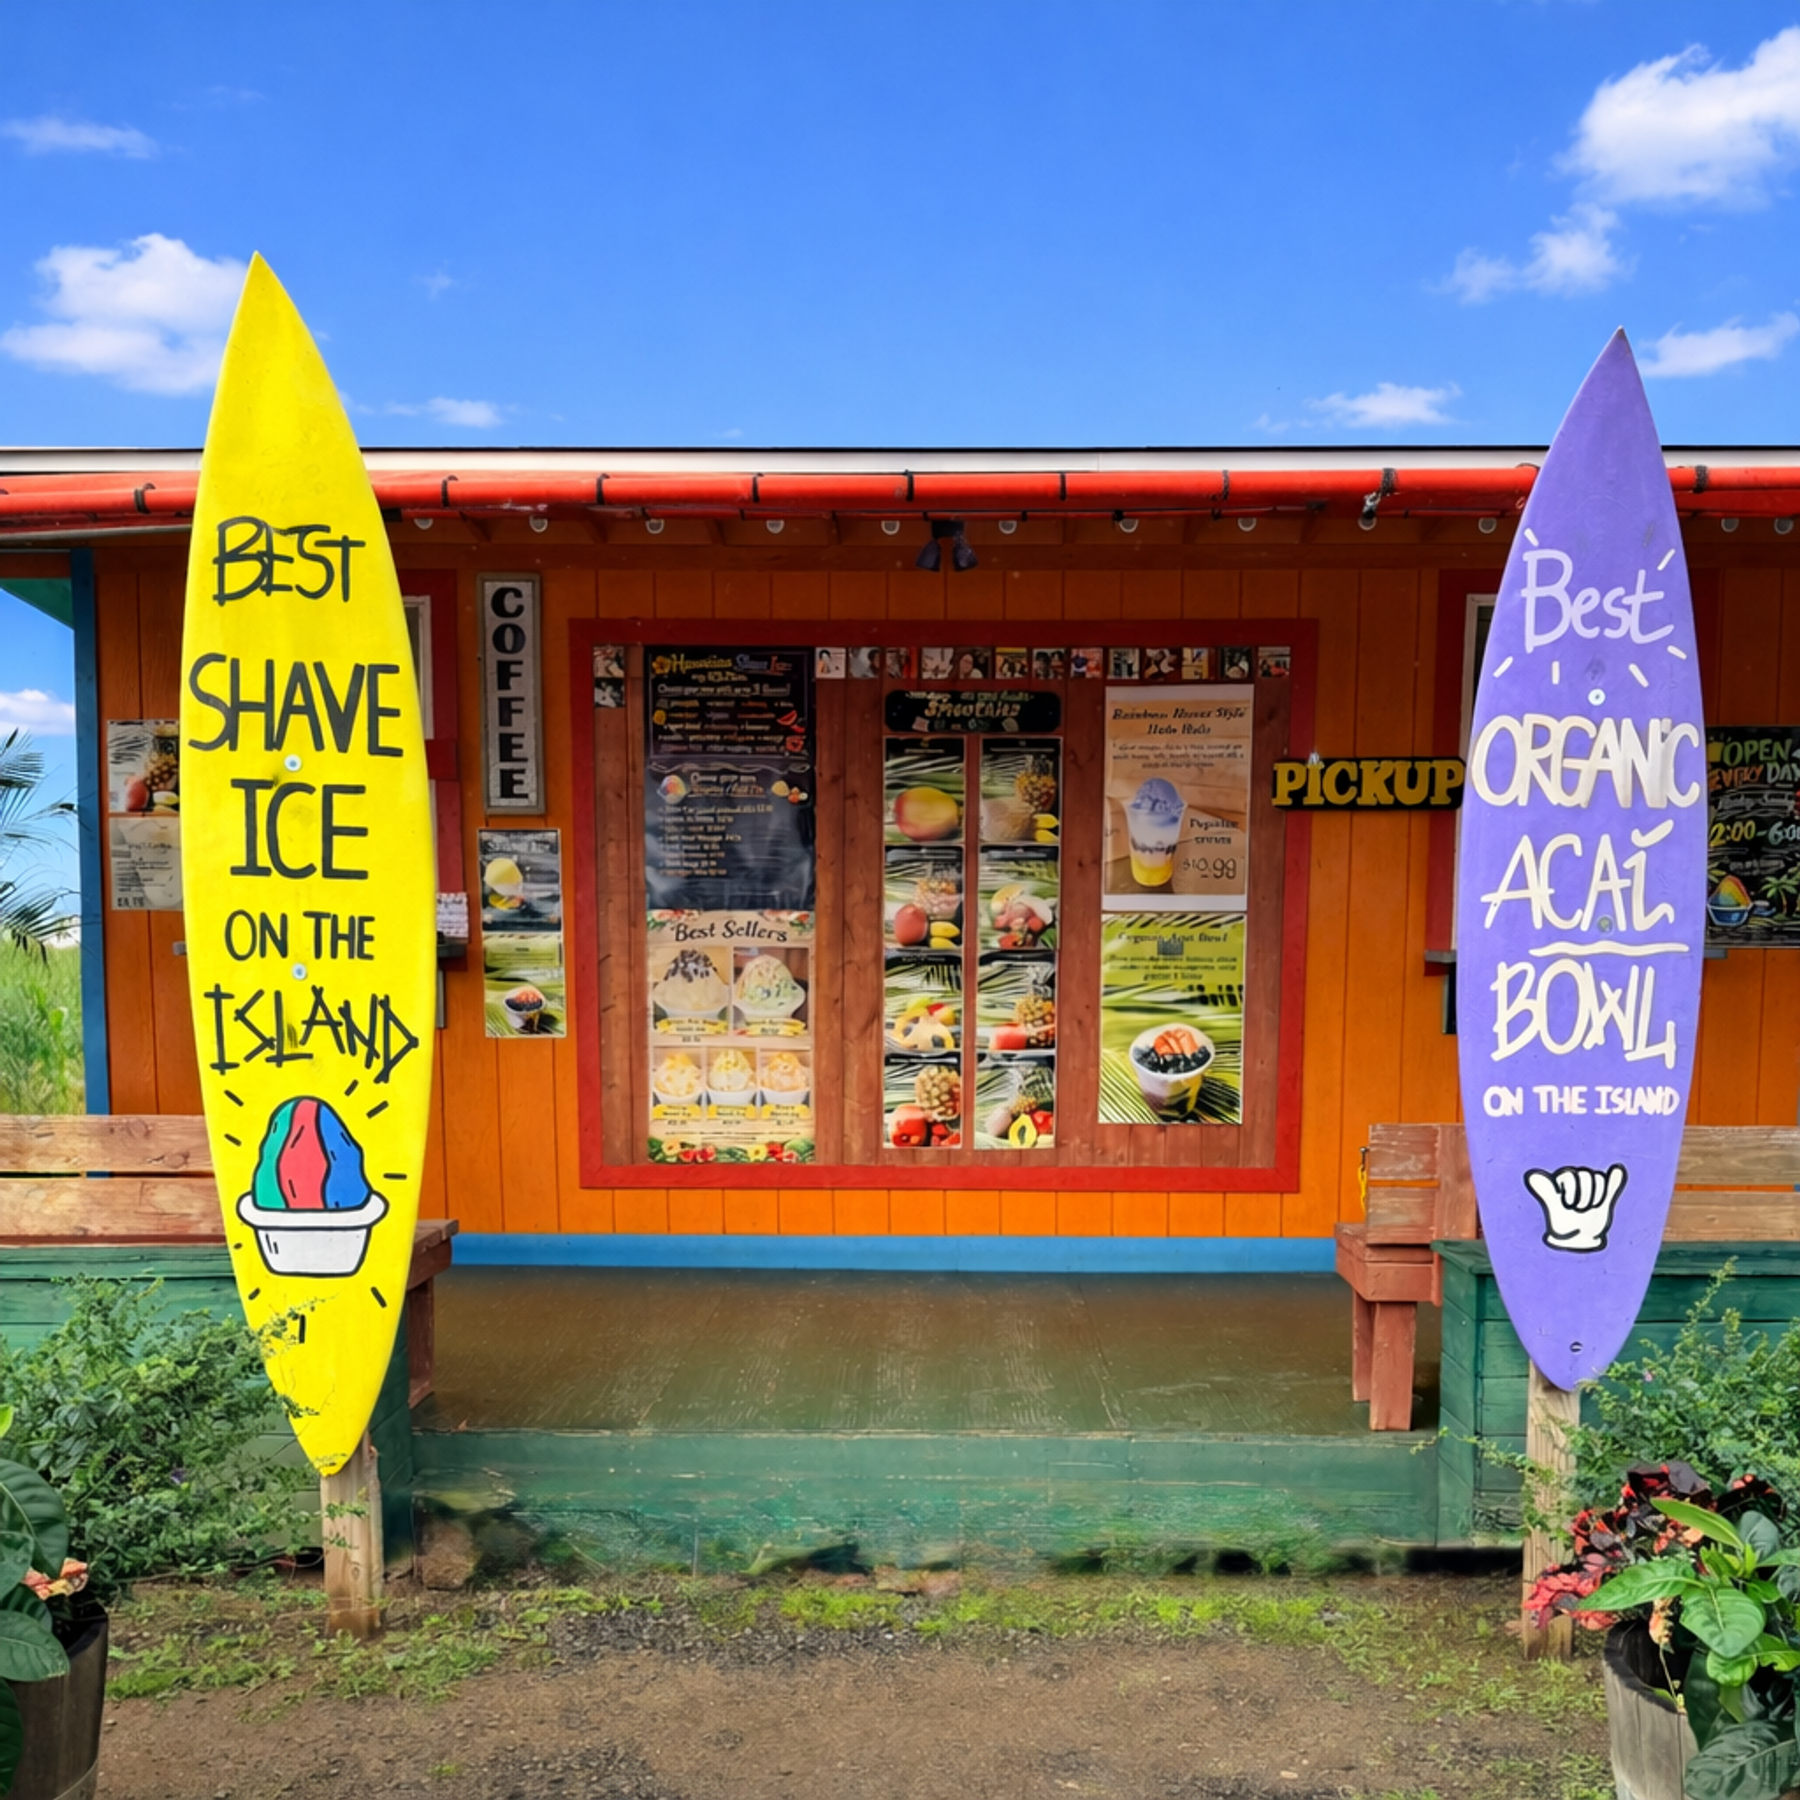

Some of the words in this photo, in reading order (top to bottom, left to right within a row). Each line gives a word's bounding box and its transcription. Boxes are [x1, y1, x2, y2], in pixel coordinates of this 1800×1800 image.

[212, 515, 366, 607] BEST
[1520, 549, 1676, 654] Best
[187, 652, 404, 758] SHAVE
[489, 586, 531, 801] COFFEE
[1271, 759, 1466, 807] PICKUP
[1471, 713, 1701, 809] ORGANIC
[1722, 738, 1792, 768] OPEN
[230, 777, 369, 880] ICE
[224, 909, 289, 962] ON
[303, 909, 376, 961] THE
[670, 921, 716, 942] Best
[722, 919, 788, 943] Sellers
[203, 983, 420, 1084] ISLAND
[1490, 958, 1677, 1070] BOWL
[1483, 1085, 1524, 1116] ON
[1533, 1084, 1588, 1115] THE
[1594, 1085, 1680, 1116] ISLAND
